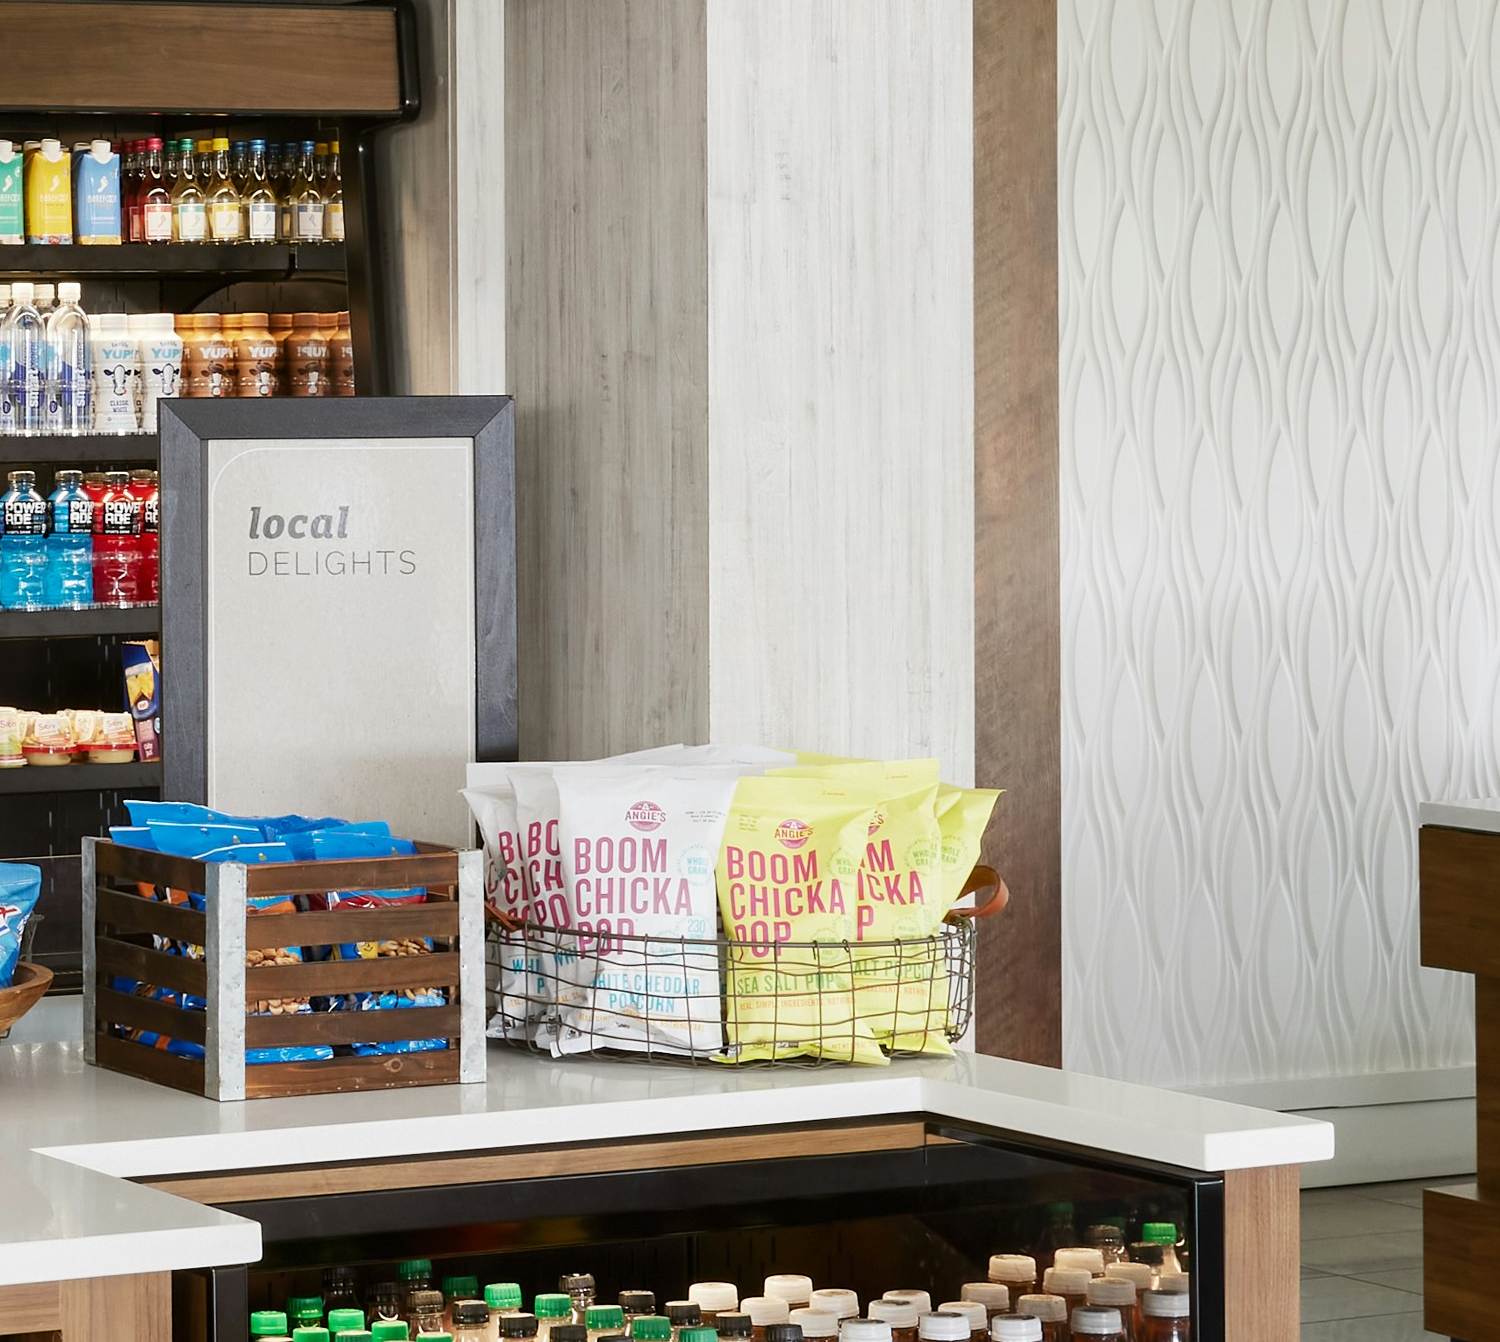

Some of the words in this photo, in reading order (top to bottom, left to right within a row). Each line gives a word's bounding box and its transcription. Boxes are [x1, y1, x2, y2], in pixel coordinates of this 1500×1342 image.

[5, 501, 46, 512] POWER
[5, 514, 31, 525] ADE
[249, 506, 349, 540] local
[248, 550, 416, 576] DELIGHTS
[625, 811, 666, 822] ANGIE'S
[774, 827, 813, 840] ANGIE'S
[574, 837, 667, 875] BOOM
[727, 845, 819, 885] BOOM
[576, 877, 693, 917] CHICKA
[731, 878, 846, 921] CHICKA
[578, 918, 635, 959] POP
[735, 920, 792, 961] POP
[634, 974, 700, 996] CHEDDAR
[737, 976, 759, 996] SEA
